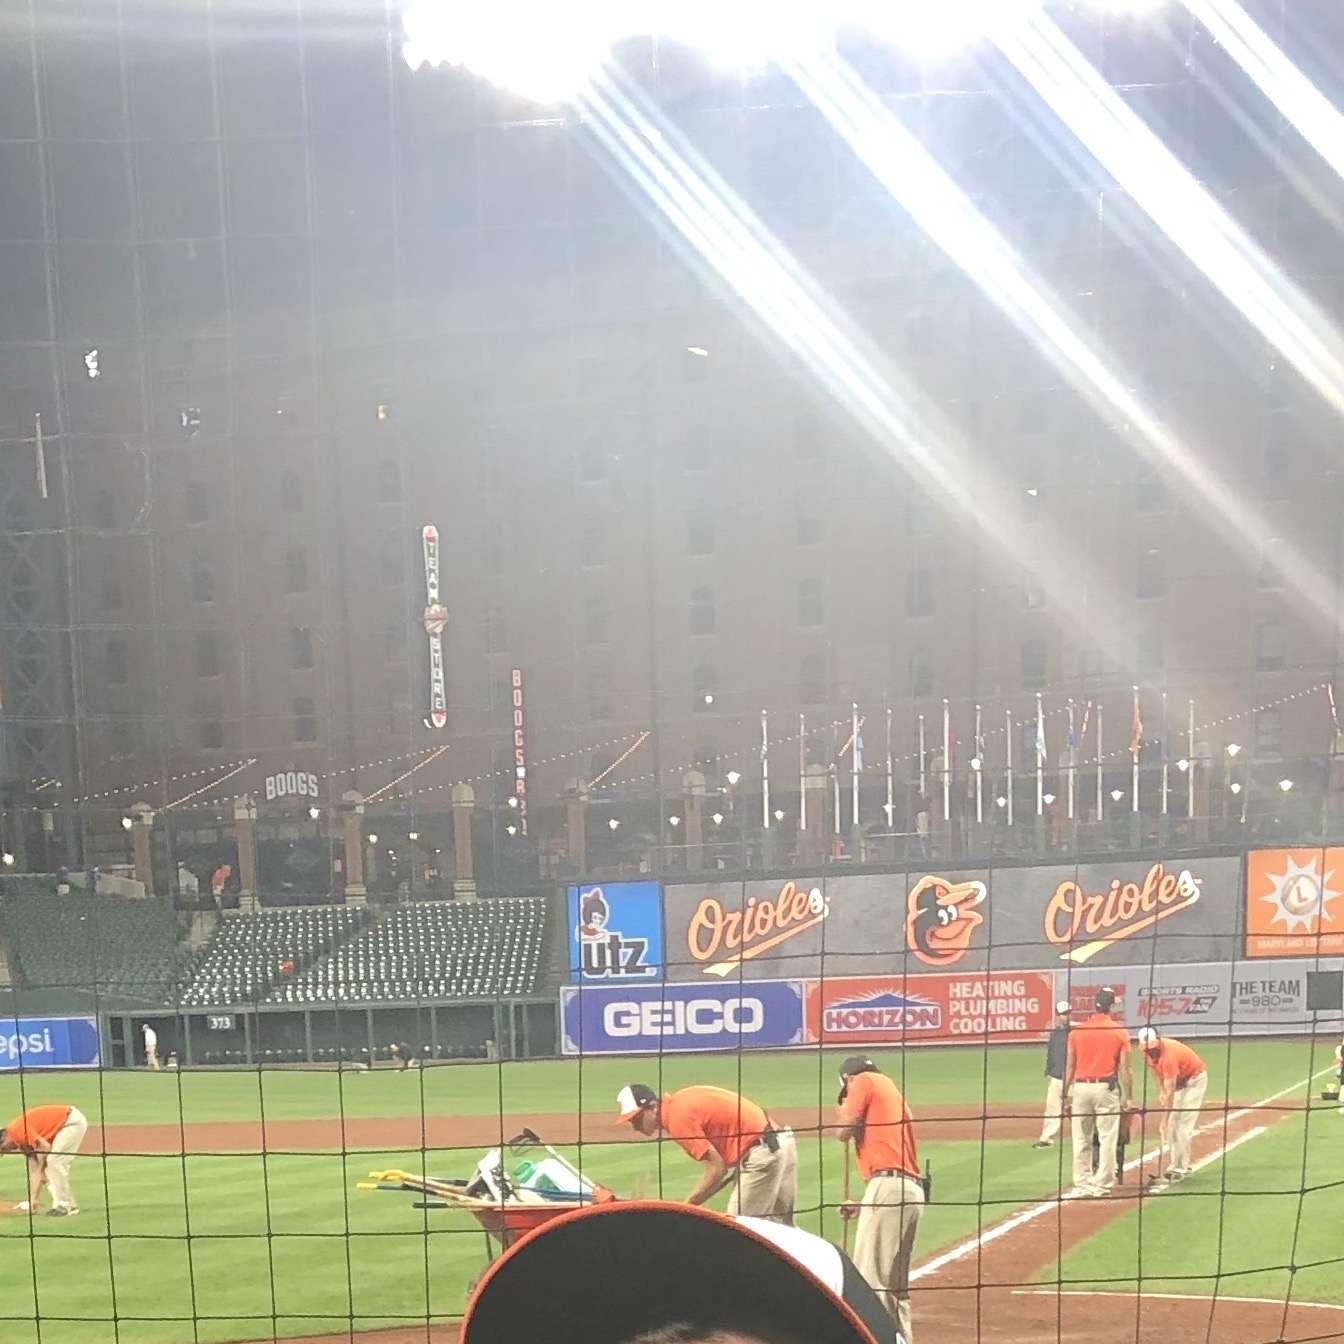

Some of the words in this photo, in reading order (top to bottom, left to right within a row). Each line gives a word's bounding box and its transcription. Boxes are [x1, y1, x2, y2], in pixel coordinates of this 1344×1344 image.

[1044, 863, 1201, 944] Orioles
[688, 881, 830, 961] Orioles
[949, 980, 1025, 998] HEATING
[1232, 981, 1256, 998] THE
[1259, 980, 1301, 997] TEAM
[949, 997, 1039, 1016] PLUMBING
[210, 1016, 232, 1030] 373
[603, 997, 765, 1038] GEICO
[825, 1008, 940, 1030] HORIZON
[949, 1016, 1027, 1034] COOLING
